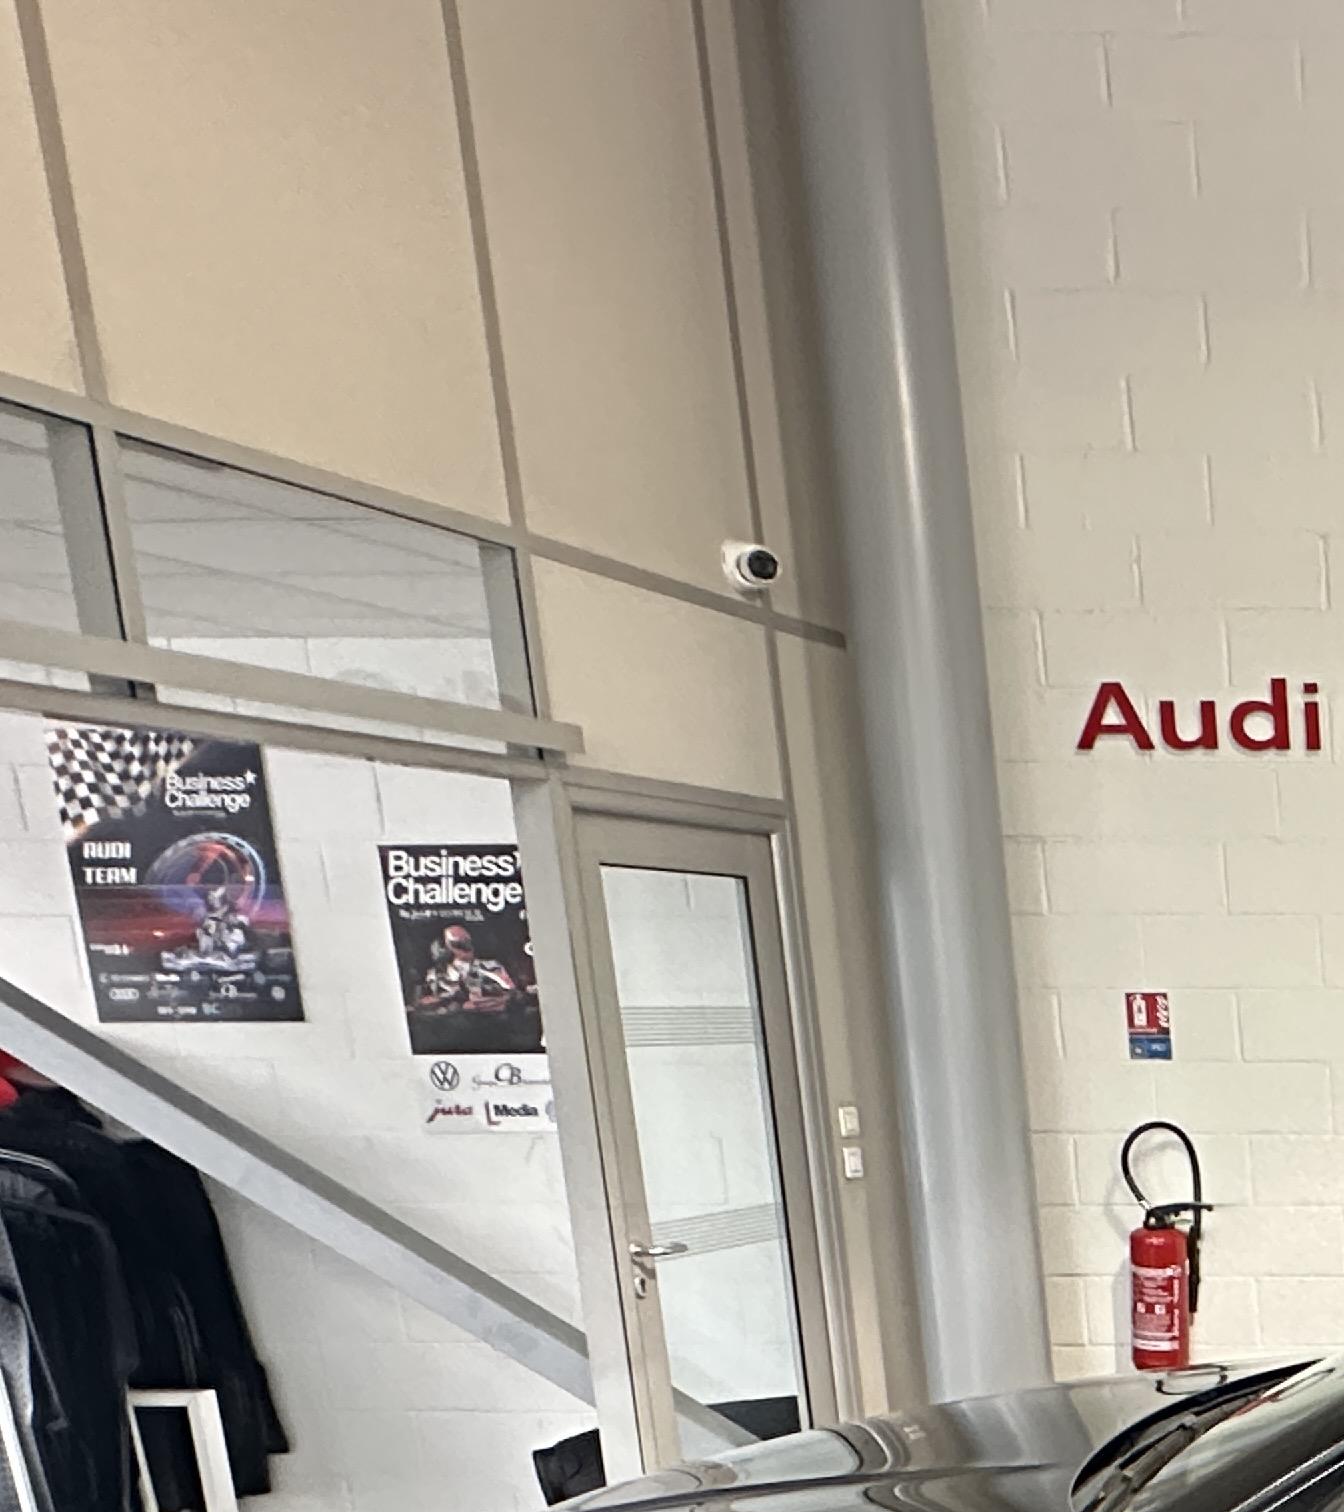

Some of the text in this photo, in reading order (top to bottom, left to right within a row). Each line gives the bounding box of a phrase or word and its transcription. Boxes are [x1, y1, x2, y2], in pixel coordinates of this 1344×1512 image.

[1076, 677, 1322, 753] Audi
[166, 770, 246, 791] Business
[164, 790, 251, 813] Challenge
[82, 840, 132, 859] AUDI
[387, 849, 515, 878] Business
[82, 866, 138, 885] TEAM
[387, 876, 523, 912] Challenge
